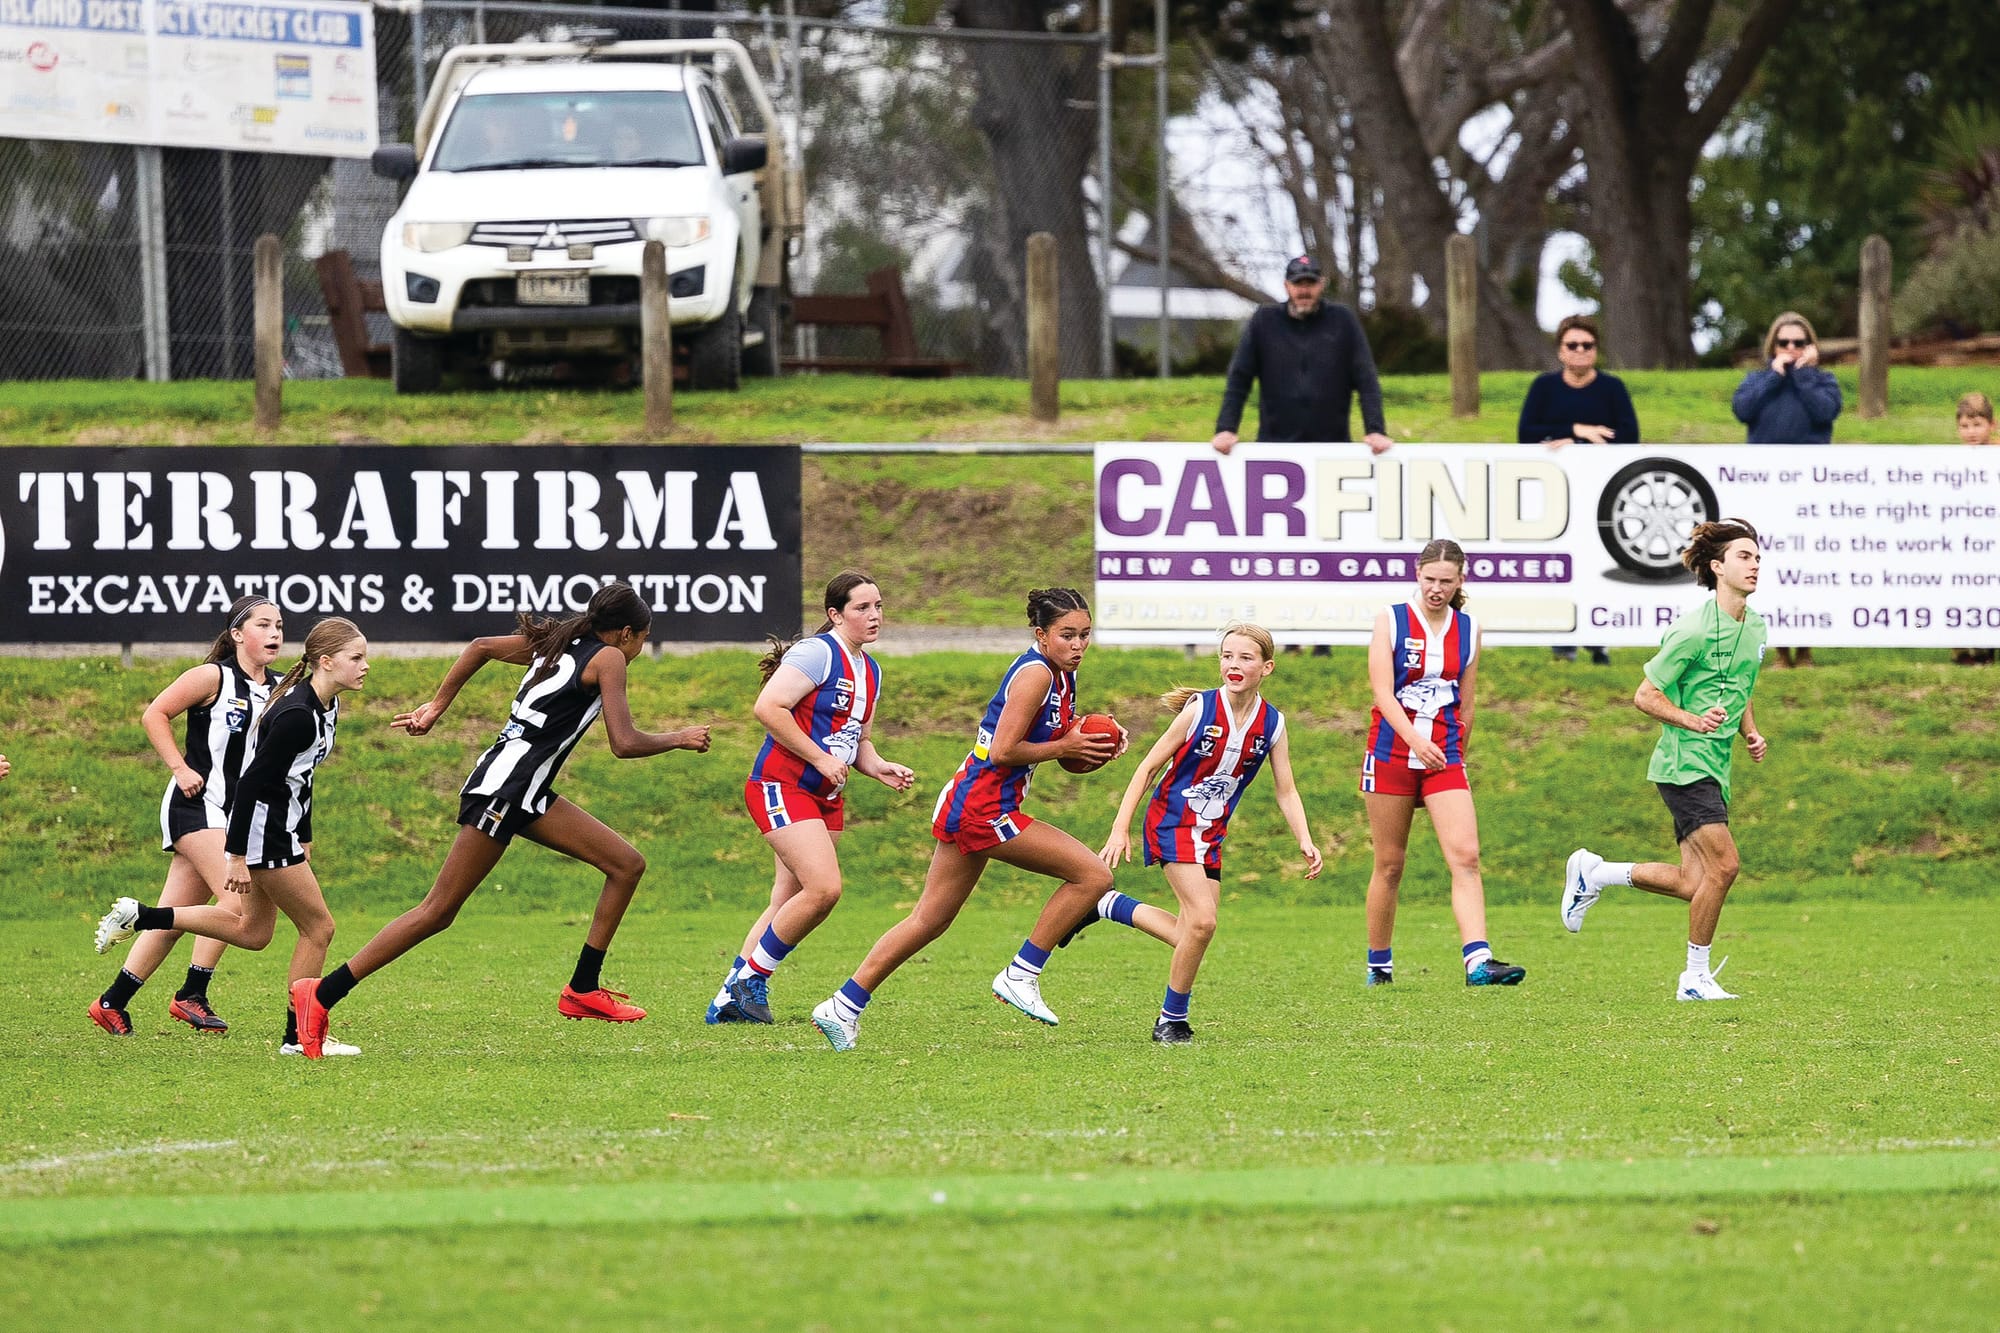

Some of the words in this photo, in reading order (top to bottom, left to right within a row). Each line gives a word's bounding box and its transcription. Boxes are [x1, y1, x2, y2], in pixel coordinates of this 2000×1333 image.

[292, 12, 350, 44] CLUB
[1719, 466, 1770, 484] New
[1779, 470, 1802, 483] or
[1813, 467, 1876, 486] Used,
[1887, 467, 1923, 483] the
[1934, 467, 1989, 490] right
[1099, 458, 1570, 541] CARFIND
[1797, 503, 1819, 518] at
[1830, 501, 1865, 518] the
[1877, 501, 1931, 525] right
[1815, 535, 1841, 553] do
[1851, 535, 1887, 553] the
[1896, 535, 1952, 553] work
[1963, 535, 1996, 553] for
[1101, 557, 1171, 577] NEW
[1190, 557, 1211, 577] &
[1230, 557, 1321, 578] USED
[1338, 558, 1407, 578] CAR
[1777, 568, 1840, 586] Want
[1850, 570, 1873, 586] to
[1883, 568, 1942, 586] know
[28, 574, 385, 614] EXCAVATIONS
[401, 574, 434, 613] &
[1103, 603, 1257, 620] FINANCE
[1591, 606, 1642, 627] Call
[1853, 606, 1932, 628] 0419
[1946, 606, 2000, 628] 930
